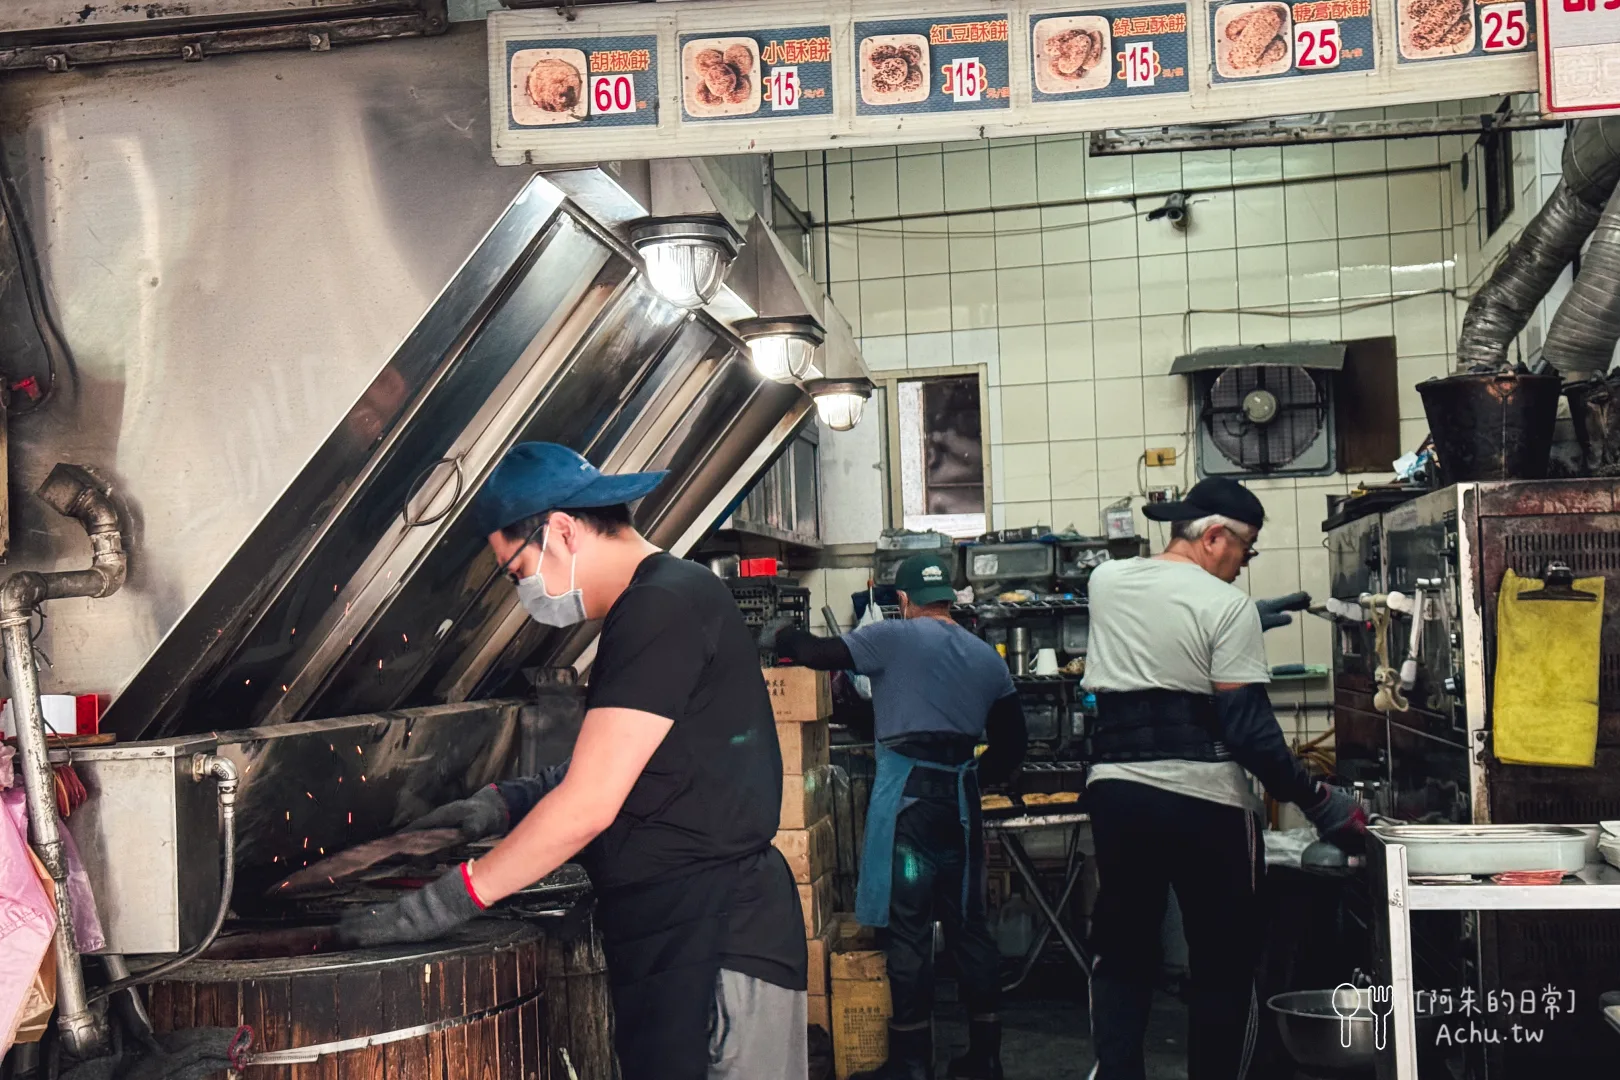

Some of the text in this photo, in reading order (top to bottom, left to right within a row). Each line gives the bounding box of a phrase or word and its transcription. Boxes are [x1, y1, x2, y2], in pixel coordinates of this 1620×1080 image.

[930, 20, 1008, 44] 紅豆酥餅
[1113, 13, 1186, 37] 綠豆酥餅
[1484, 9, 1525, 48] 25
[590, 49, 650, 72] 胡椒餅
[761, 37, 832, 64] 小酥餅
[1298, 28, 1337, 66] 25
[956, 62, 977, 96] 15
[1129, 47, 1150, 81] 15
[595, 77, 631, 111] 60
[774, 72, 795, 105] 15
